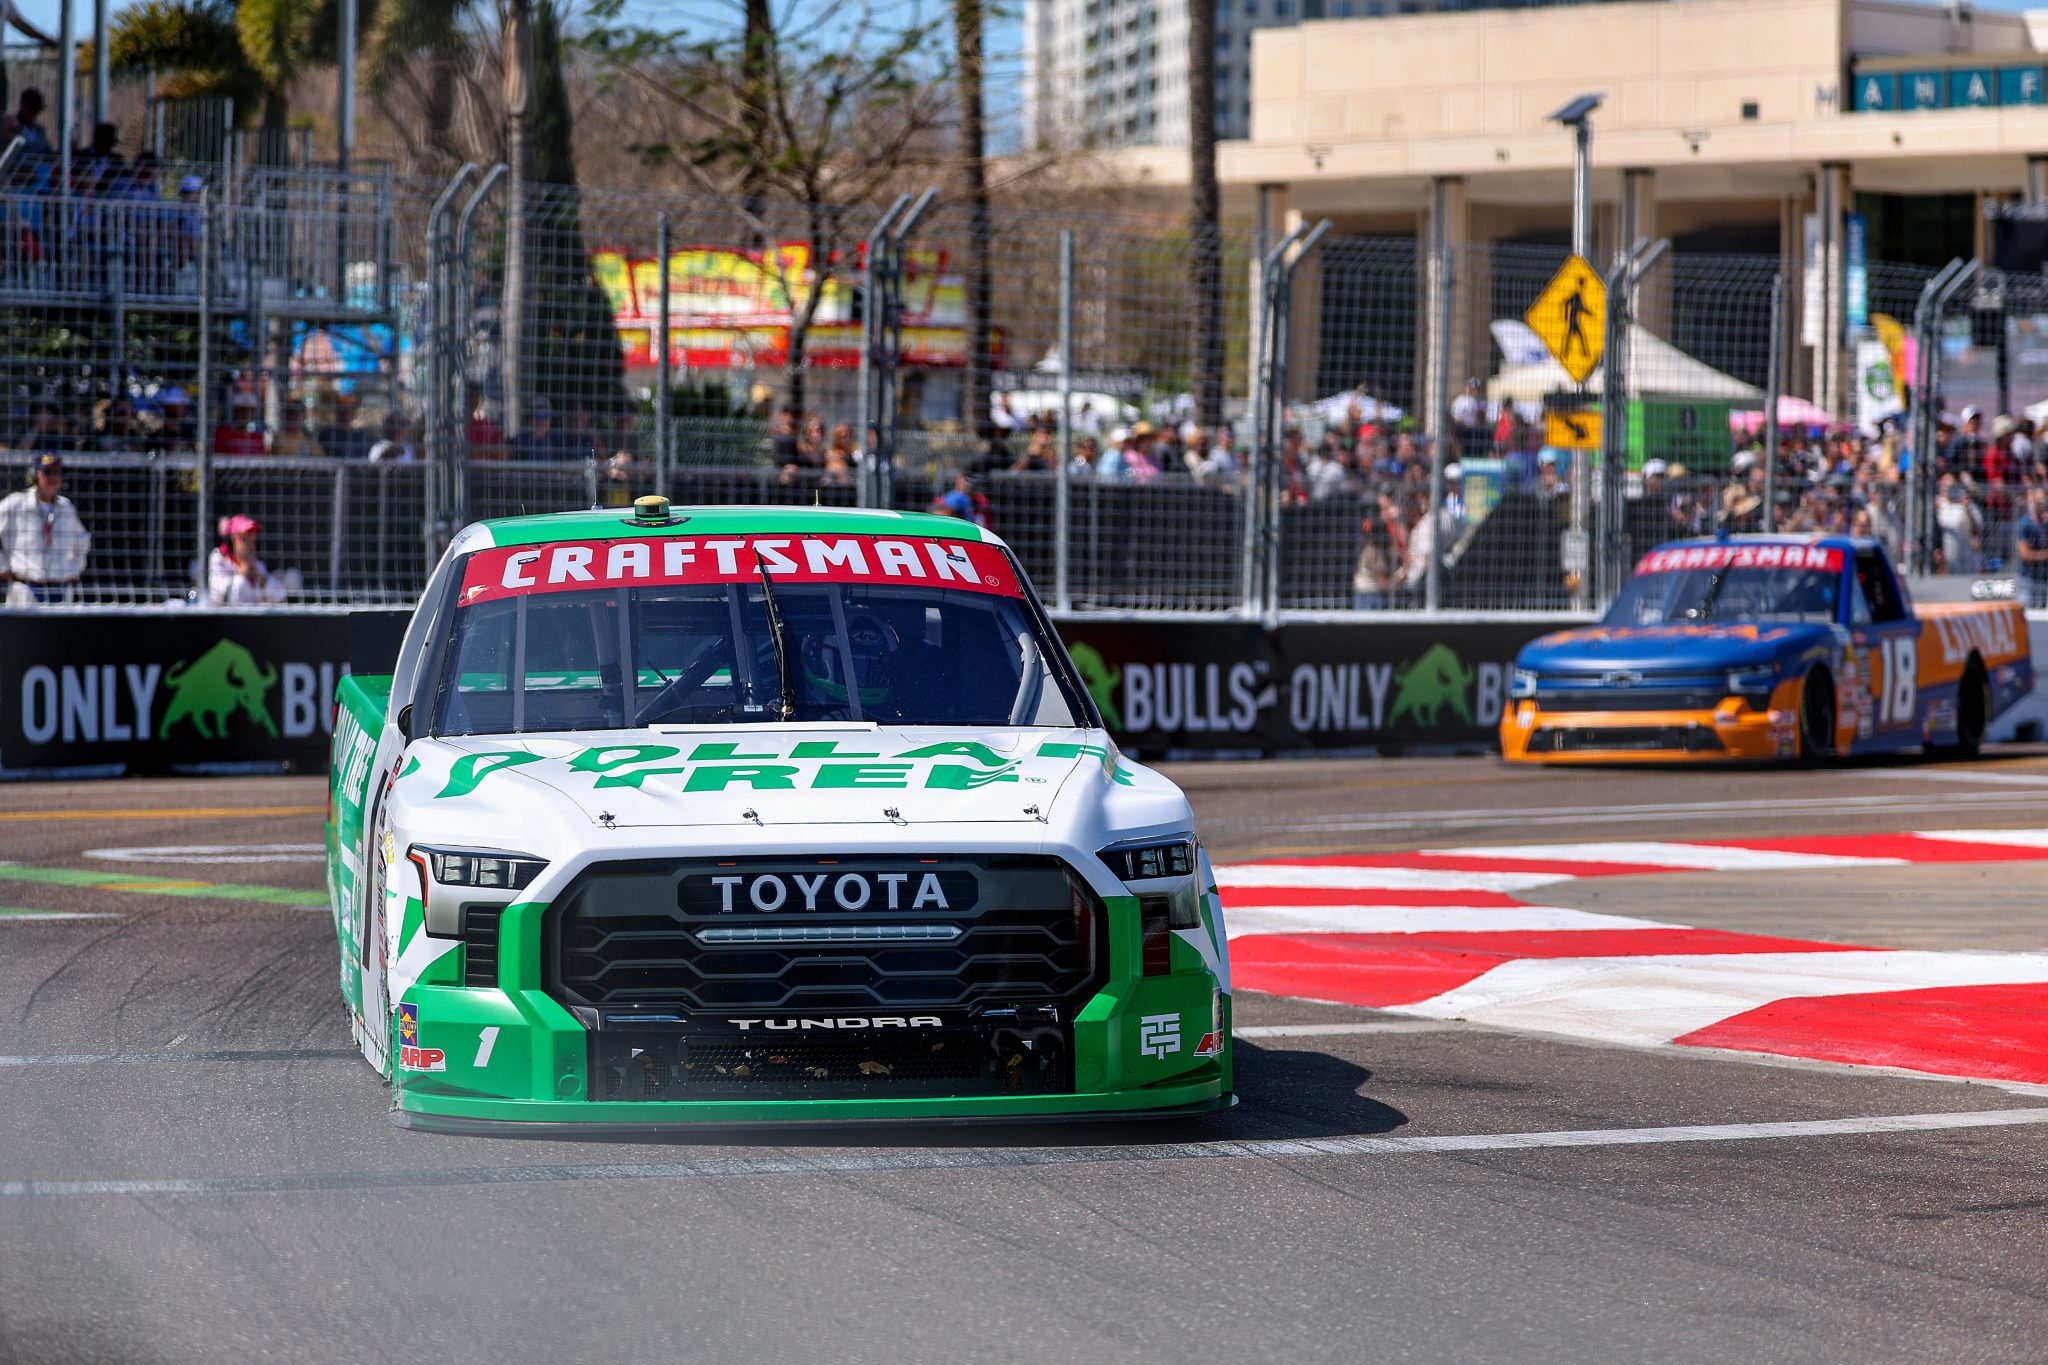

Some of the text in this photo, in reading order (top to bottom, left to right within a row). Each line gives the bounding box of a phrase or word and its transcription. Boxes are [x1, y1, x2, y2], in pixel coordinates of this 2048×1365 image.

[501, 539, 982, 589] CRAFTSMAN
[1651, 545, 1828, 572] CRAFTSMAN
[1123, 662, 1258, 732] BULLS
[1290, 661, 1392, 731] ONLY
[1881, 636, 1917, 724] 18
[21, 663, 162, 745] ONLY
[593, 763, 1019, 793] TREE
[711, 873, 950, 913] TOYOTA
[727, 1015, 943, 1031] TUNDRA
[399, 1046, 445, 1069] ARP
[473, 1026, 500, 1068] 1
